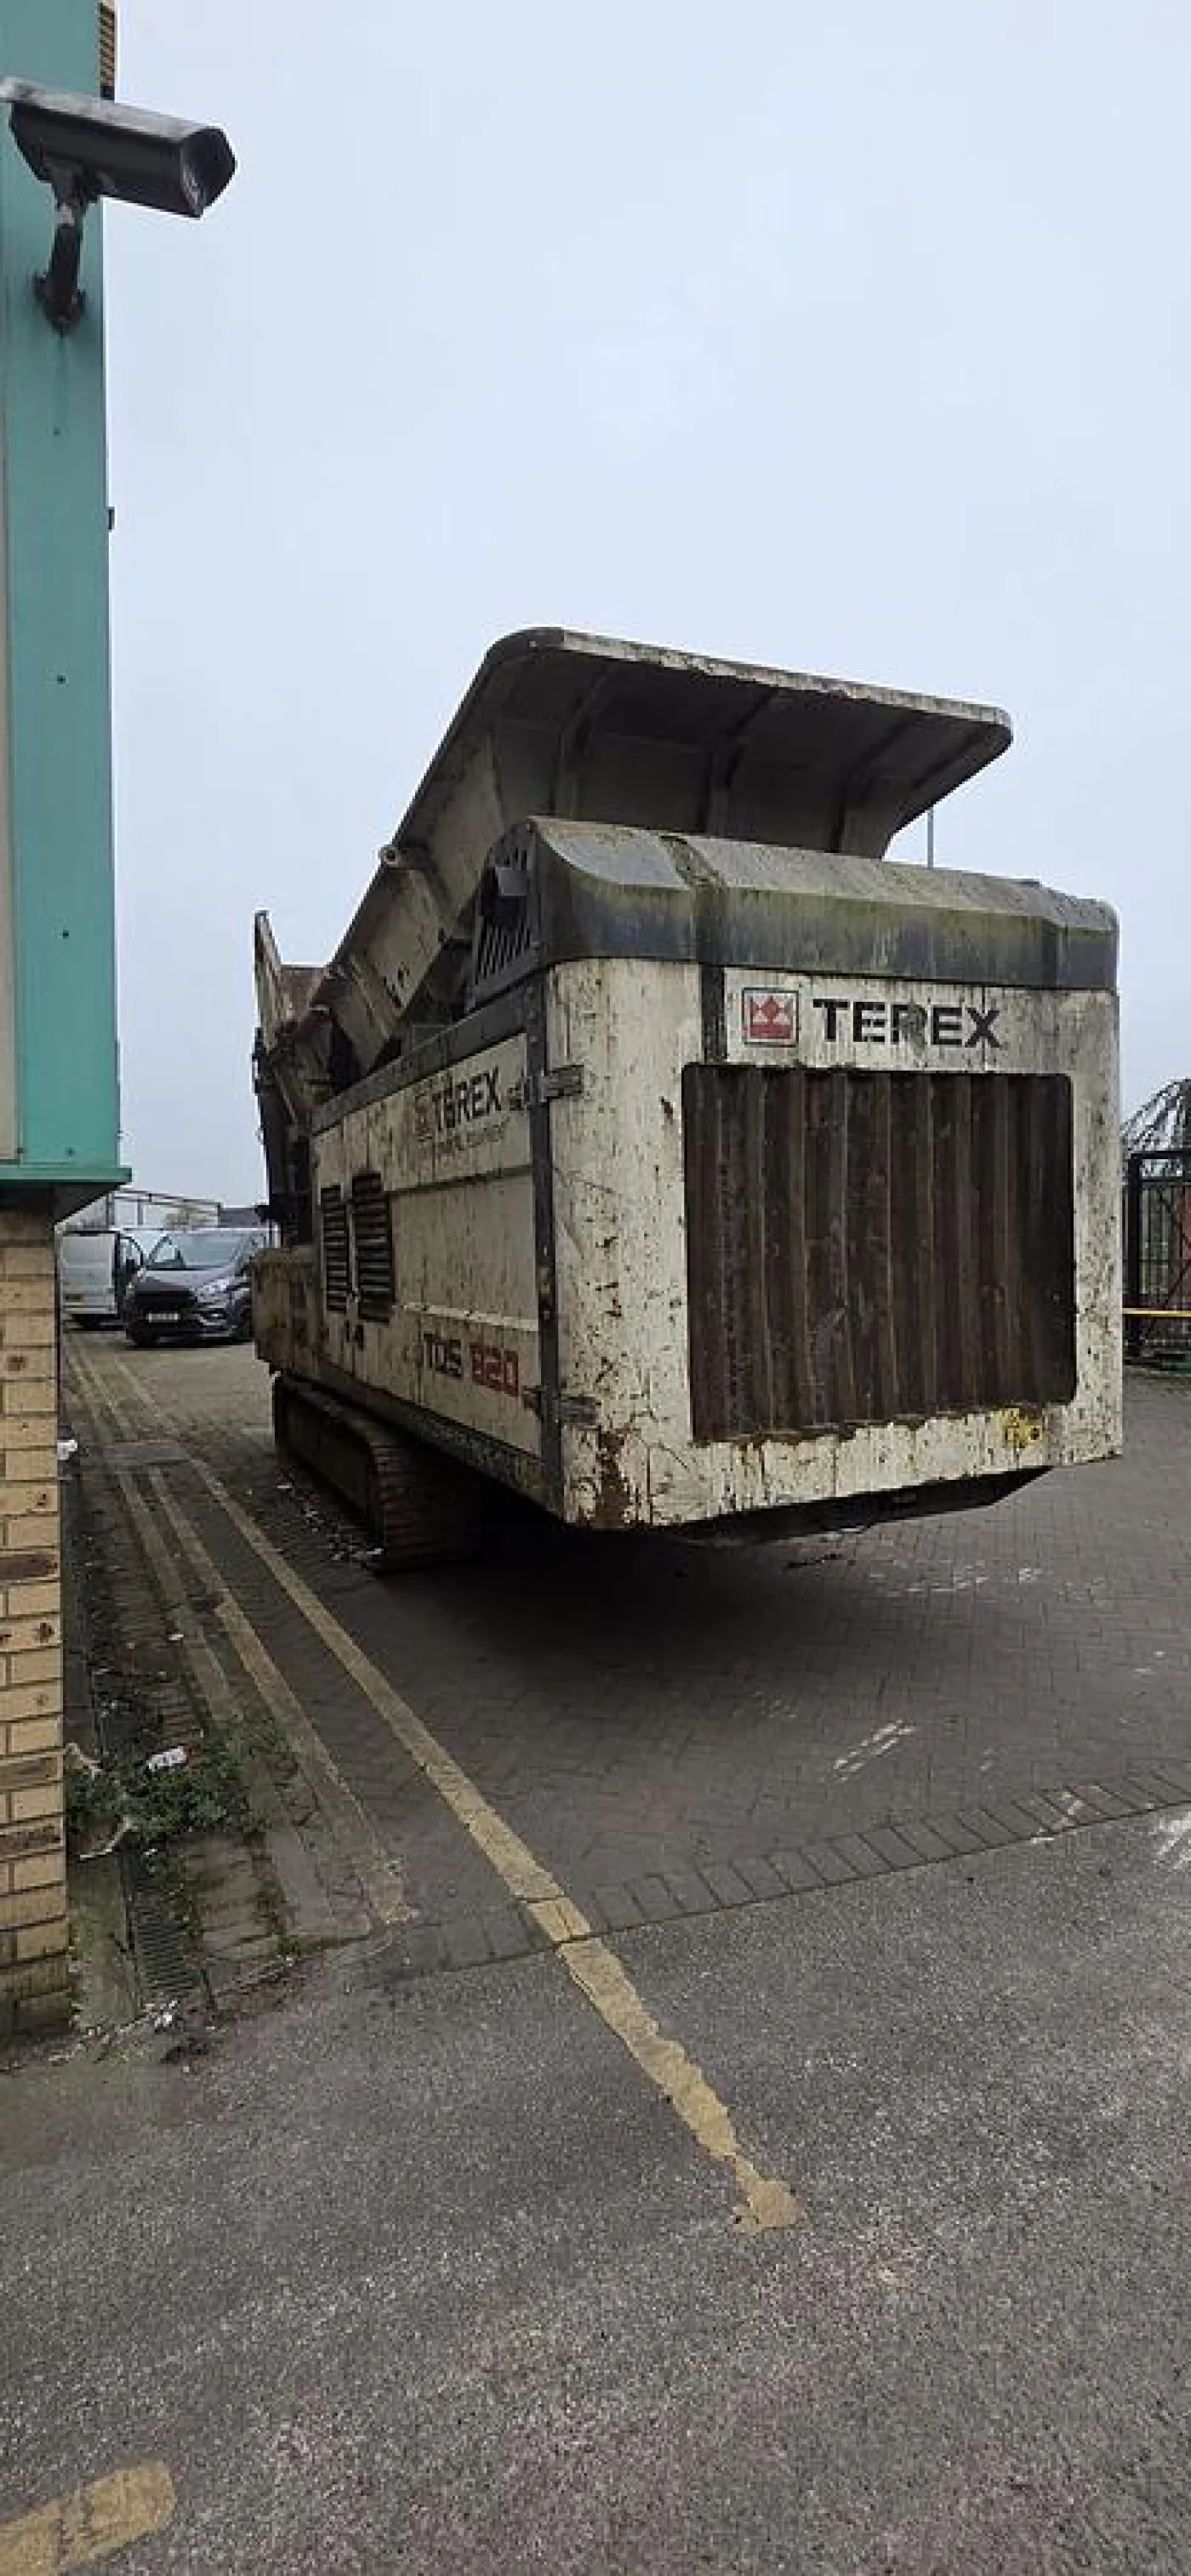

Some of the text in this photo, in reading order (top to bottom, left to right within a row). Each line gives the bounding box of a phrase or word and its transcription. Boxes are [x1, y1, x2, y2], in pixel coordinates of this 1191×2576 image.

[812, 998, 1000, 1049] TEREX
[432, 1066, 502, 1132] TEREX
[470, 1343, 519, 1397] 820
